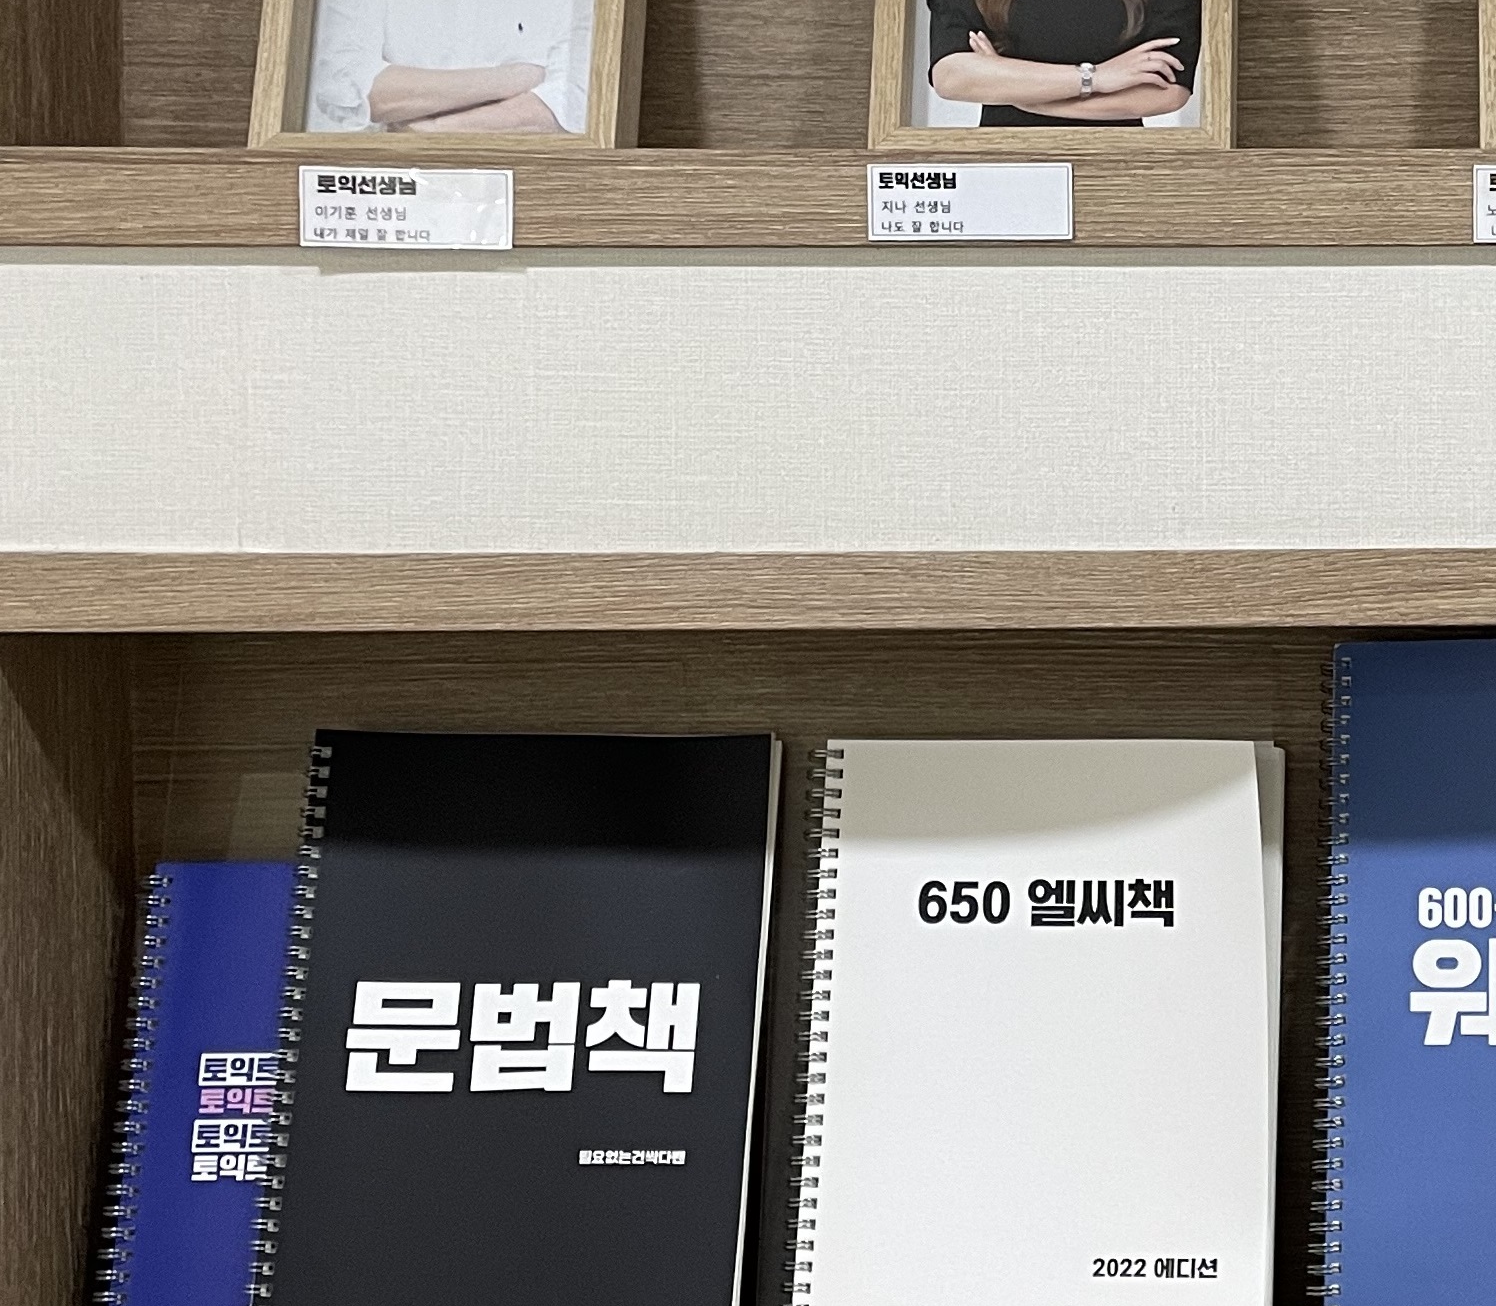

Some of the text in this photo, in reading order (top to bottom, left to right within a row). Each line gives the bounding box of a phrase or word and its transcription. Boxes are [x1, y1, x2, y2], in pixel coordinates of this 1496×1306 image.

[317, 174, 417, 196] 토익선생님
[878, 172, 957, 190] 토익선생님
[315, 205, 407, 222] 이기훈 선생님
[882, 200, 951, 214] 지나 선생님
[313, 227, 338, 240] 내가
[881, 221, 964, 233] 나도 잘 합니다
[918, 878, 1175, 928] 650 엘씨책
[345, 980, 701, 1094] 문법책
[1092, 1257, 1218, 1279] 2022 에디션
